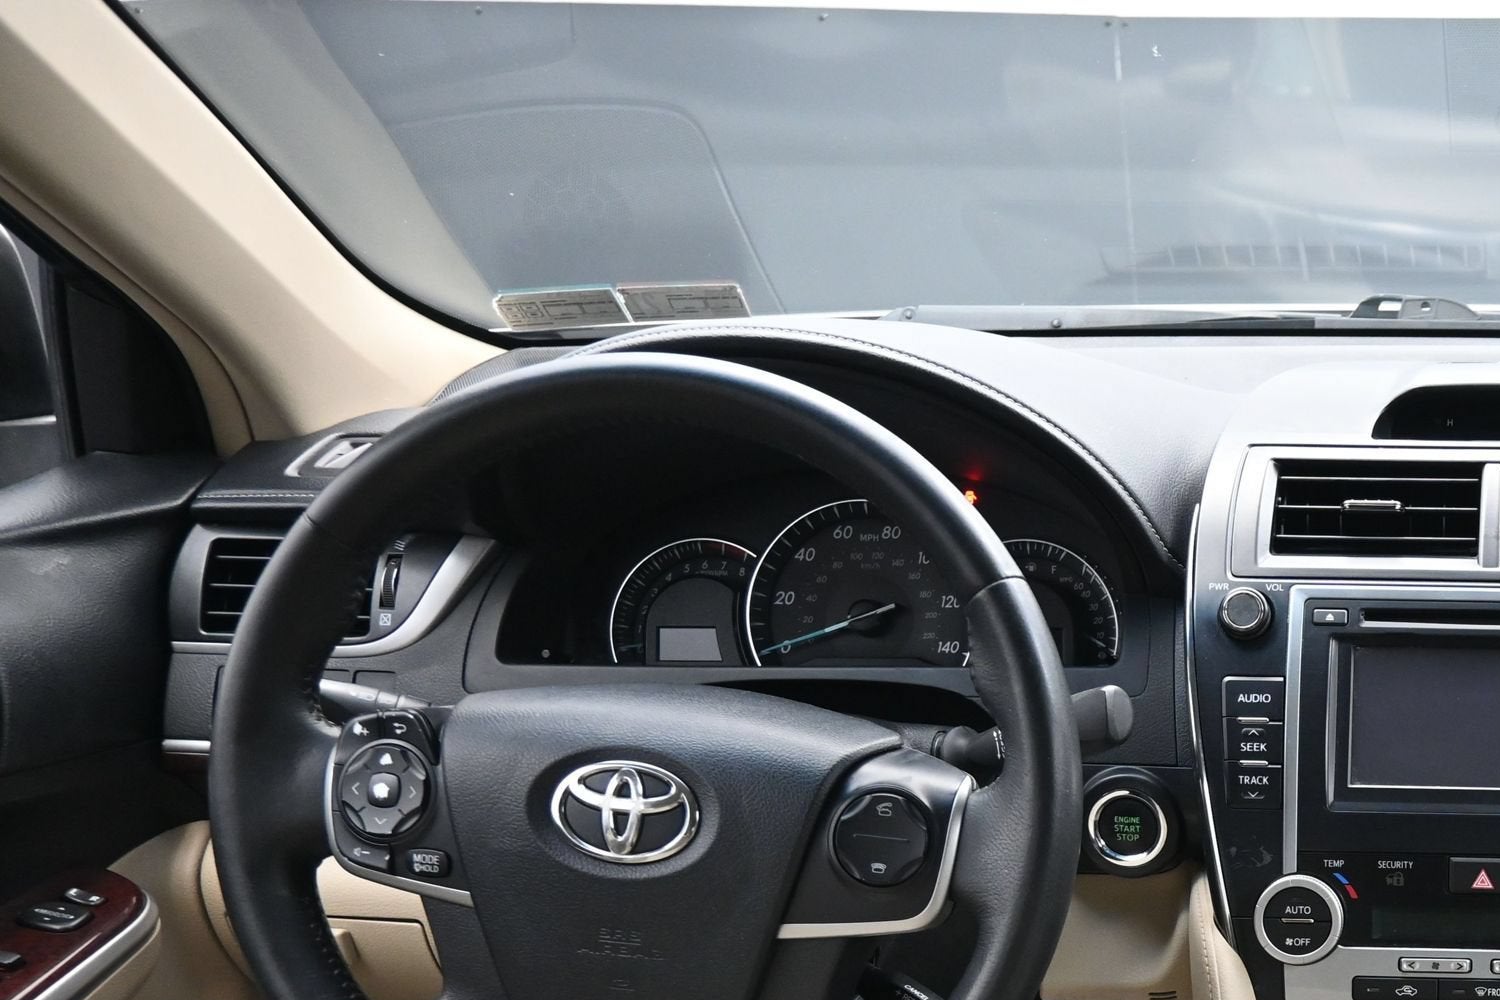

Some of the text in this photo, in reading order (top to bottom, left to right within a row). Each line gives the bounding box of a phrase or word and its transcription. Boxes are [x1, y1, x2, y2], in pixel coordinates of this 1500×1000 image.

[832, 525, 853, 540] 60
[881, 525, 902, 540] 80
[859, 533, 880, 543] MPH
[794, 547, 816, 562] 40
[683, 563, 691, 573] 5
[701, 560, 709, 570] 6
[720, 560, 728, 570] 7
[1051, 565, 1058, 575] F
[664, 572, 673, 582] 4
[738, 567, 746, 577] 8
[1073, 582, 1085, 591] 60
[1208, 582, 1230, 591] PWR
[1265, 583, 1285, 591] VOL
[773, 591, 795, 605] 20
[936, 640, 960, 654] 140
[1237, 693, 1272, 703] AUDIO
[1240, 742, 1268, 752] SEEK
[1238, 775, 1270, 785] TRACK
[1113, 815, 1141, 824] ENGINE
[1113, 824, 1141, 833] START
[1116, 833, 1140, 842] STOP
[412, 852, 440, 866] MODE
[1323, 859, 1345, 868] TEMP
[420, 863, 440, 873] HOLD
[1377, 860, 1414, 869] SECURITY
[1284, 905, 1312, 915] AUTO
[1293, 937, 1312, 947] OFF
